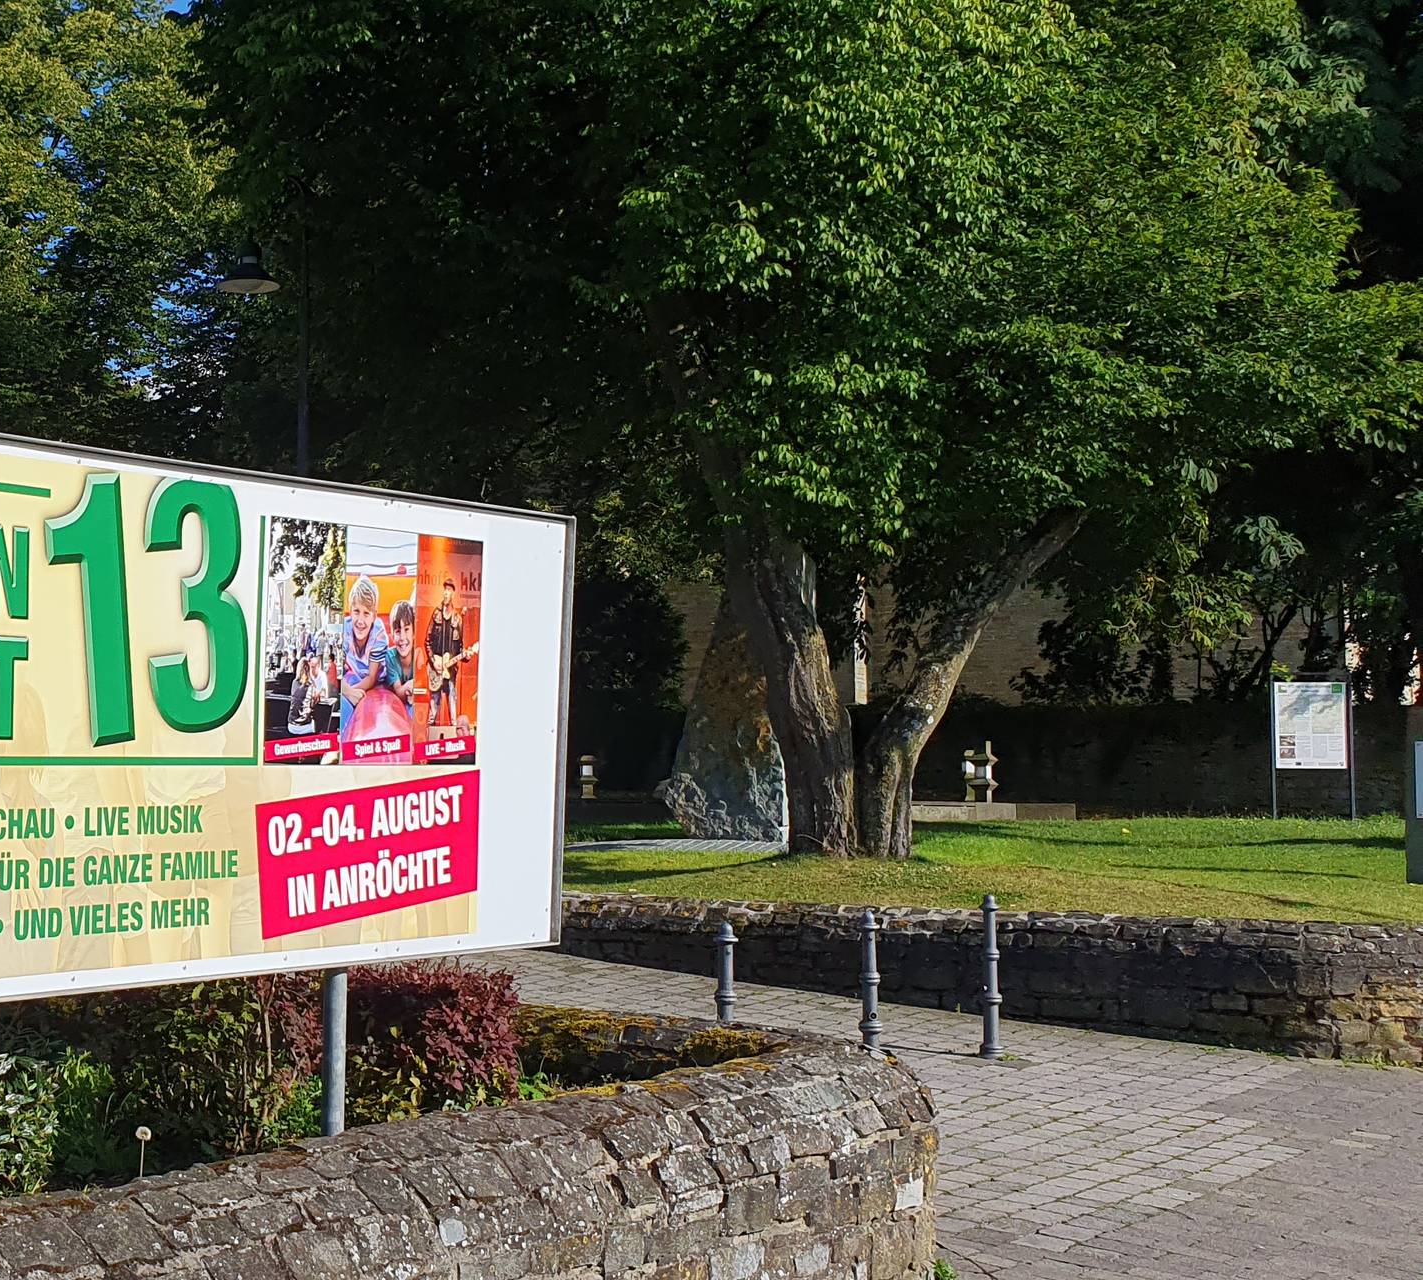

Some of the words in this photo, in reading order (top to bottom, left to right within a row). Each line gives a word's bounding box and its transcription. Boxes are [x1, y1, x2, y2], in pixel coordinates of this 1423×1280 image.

[44, 472, 248, 747] 13
[274, 738, 331, 756] Gewerbeschau
[354, 740, 374, 756] Spiel
[383, 738, 401, 753] Spaß
[424, 742, 440, 756] LIVE
[445, 739, 466, 753] Musik
[84, 806, 129, 837] LIVE
[136, 805, 203, 835] MUSIK
[267, 804, 364, 857] 02.-04.
[371, 784, 463, 838] AUGUST
[39, 856, 75, 889] DIE
[83, 853, 153, 886] GANZE
[160, 849, 239, 881] FAMILIE
[287, 872, 316, 918] IN
[322, 846, 452, 911] ANRÖCHTE
[13, 908, 63, 941] UND
[69, 901, 144, 936] VIELES
[151, 898, 210, 929] MEHR
